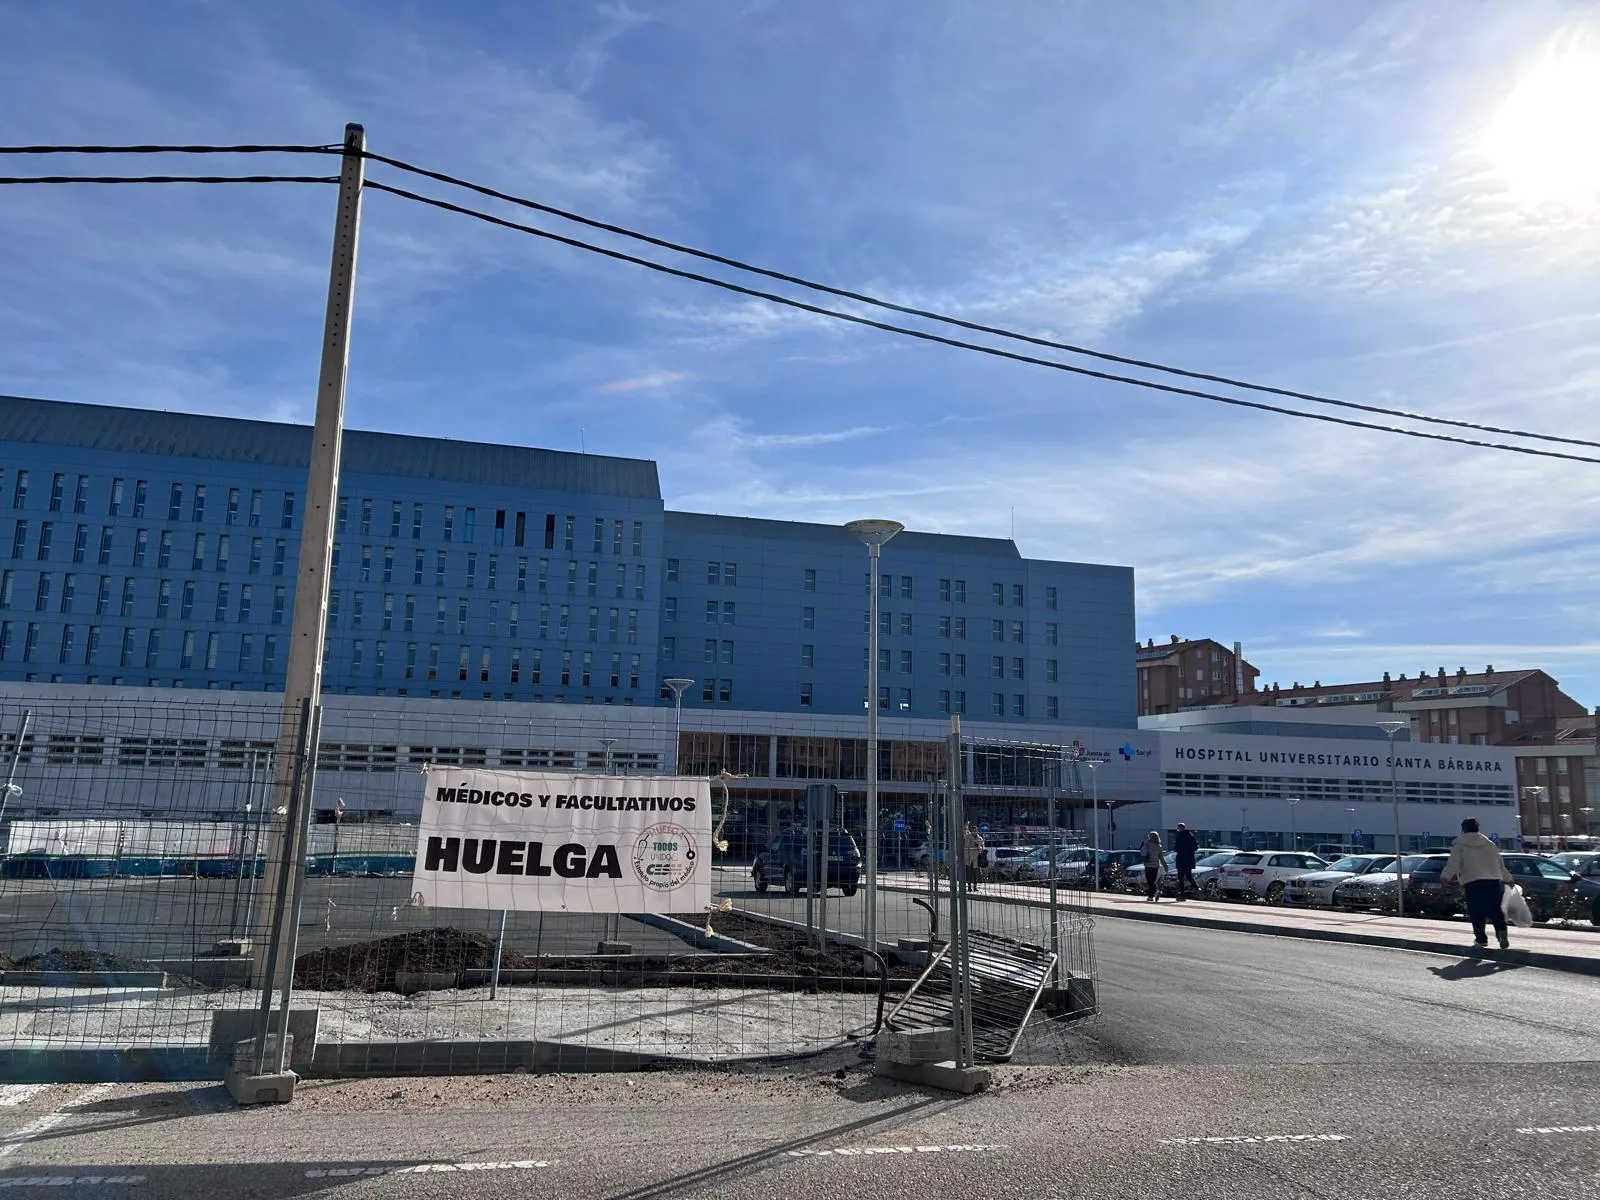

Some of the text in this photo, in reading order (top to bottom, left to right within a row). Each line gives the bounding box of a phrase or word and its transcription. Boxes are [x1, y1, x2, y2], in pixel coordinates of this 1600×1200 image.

[1175, 747, 1502, 772] HOSPITAL UNIVERSITARIO SANTA BÁRBARA
[436, 783, 696, 812] MÉDICOS Y FACULTATIVOS
[424, 836, 622, 879] HUELGA
[652, 842, 678, 852] TODOS
[649, 880, 669, 889] propio
[670, 877, 680, 887] del
